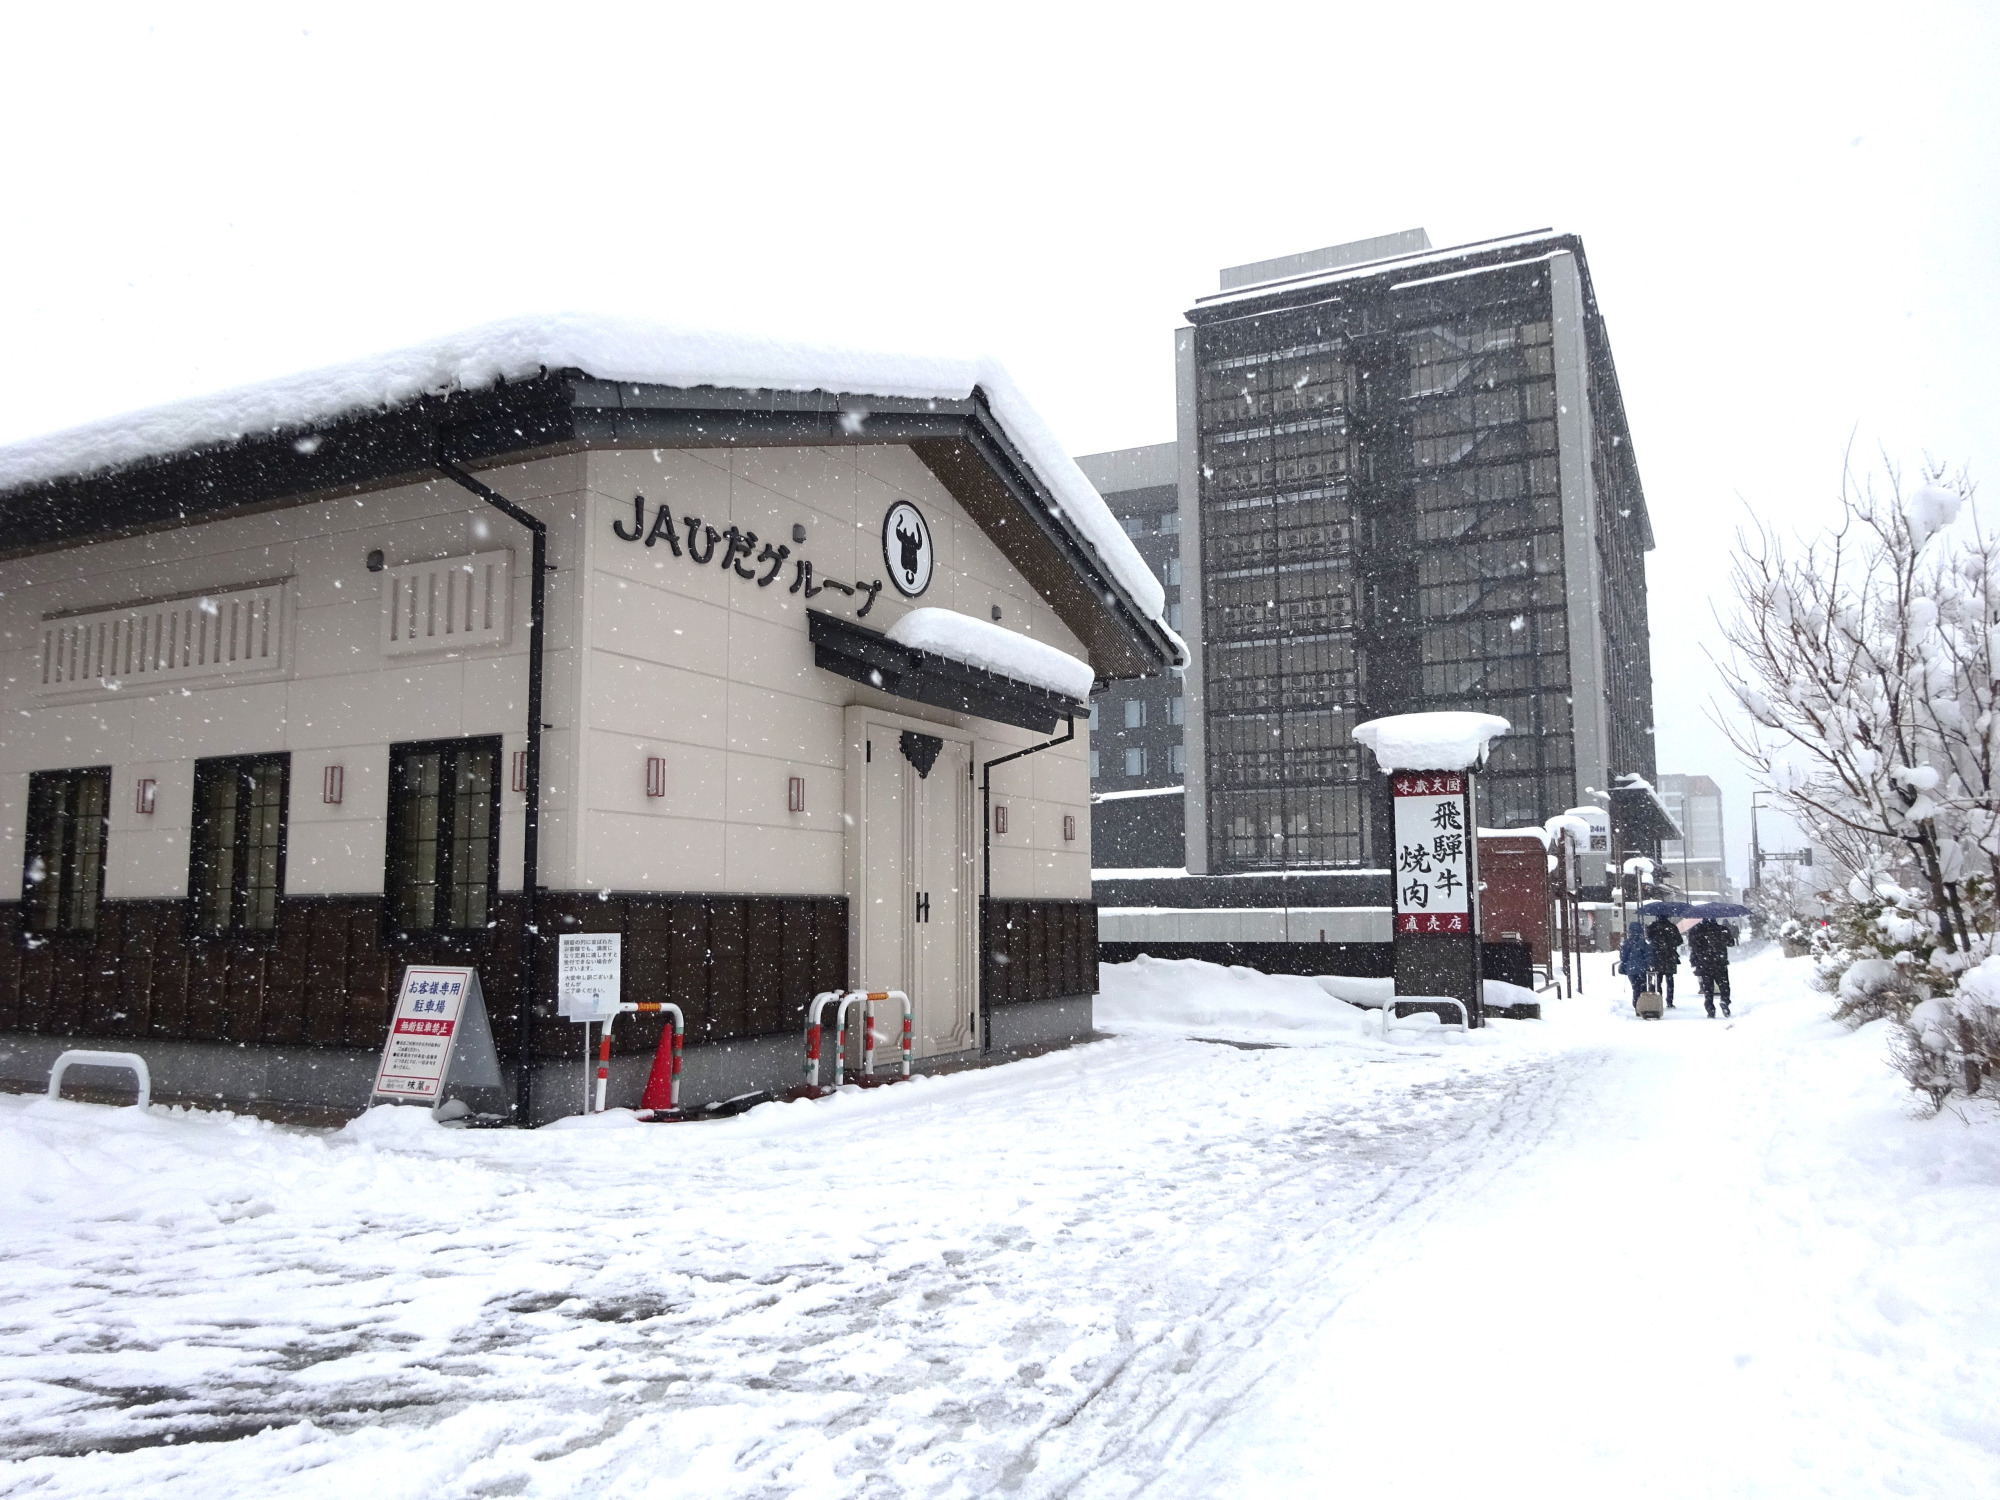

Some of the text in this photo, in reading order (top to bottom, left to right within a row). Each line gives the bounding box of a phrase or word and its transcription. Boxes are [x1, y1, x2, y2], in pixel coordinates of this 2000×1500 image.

[613, 496, 882, 617] JAひだグループ
[1396, 777, 1461, 795] 味蔵天国
[1430, 801, 1464, 899] 飛騨牛
[1398, 844, 1432, 909] 焼肉
[1405, 915, 1462, 931] 直売店
[409, 981, 461, 996] お客様専用
[413, 999, 446, 1014] 駐車場
[400, 1021, 447, 1035] 無断駐車禁止
